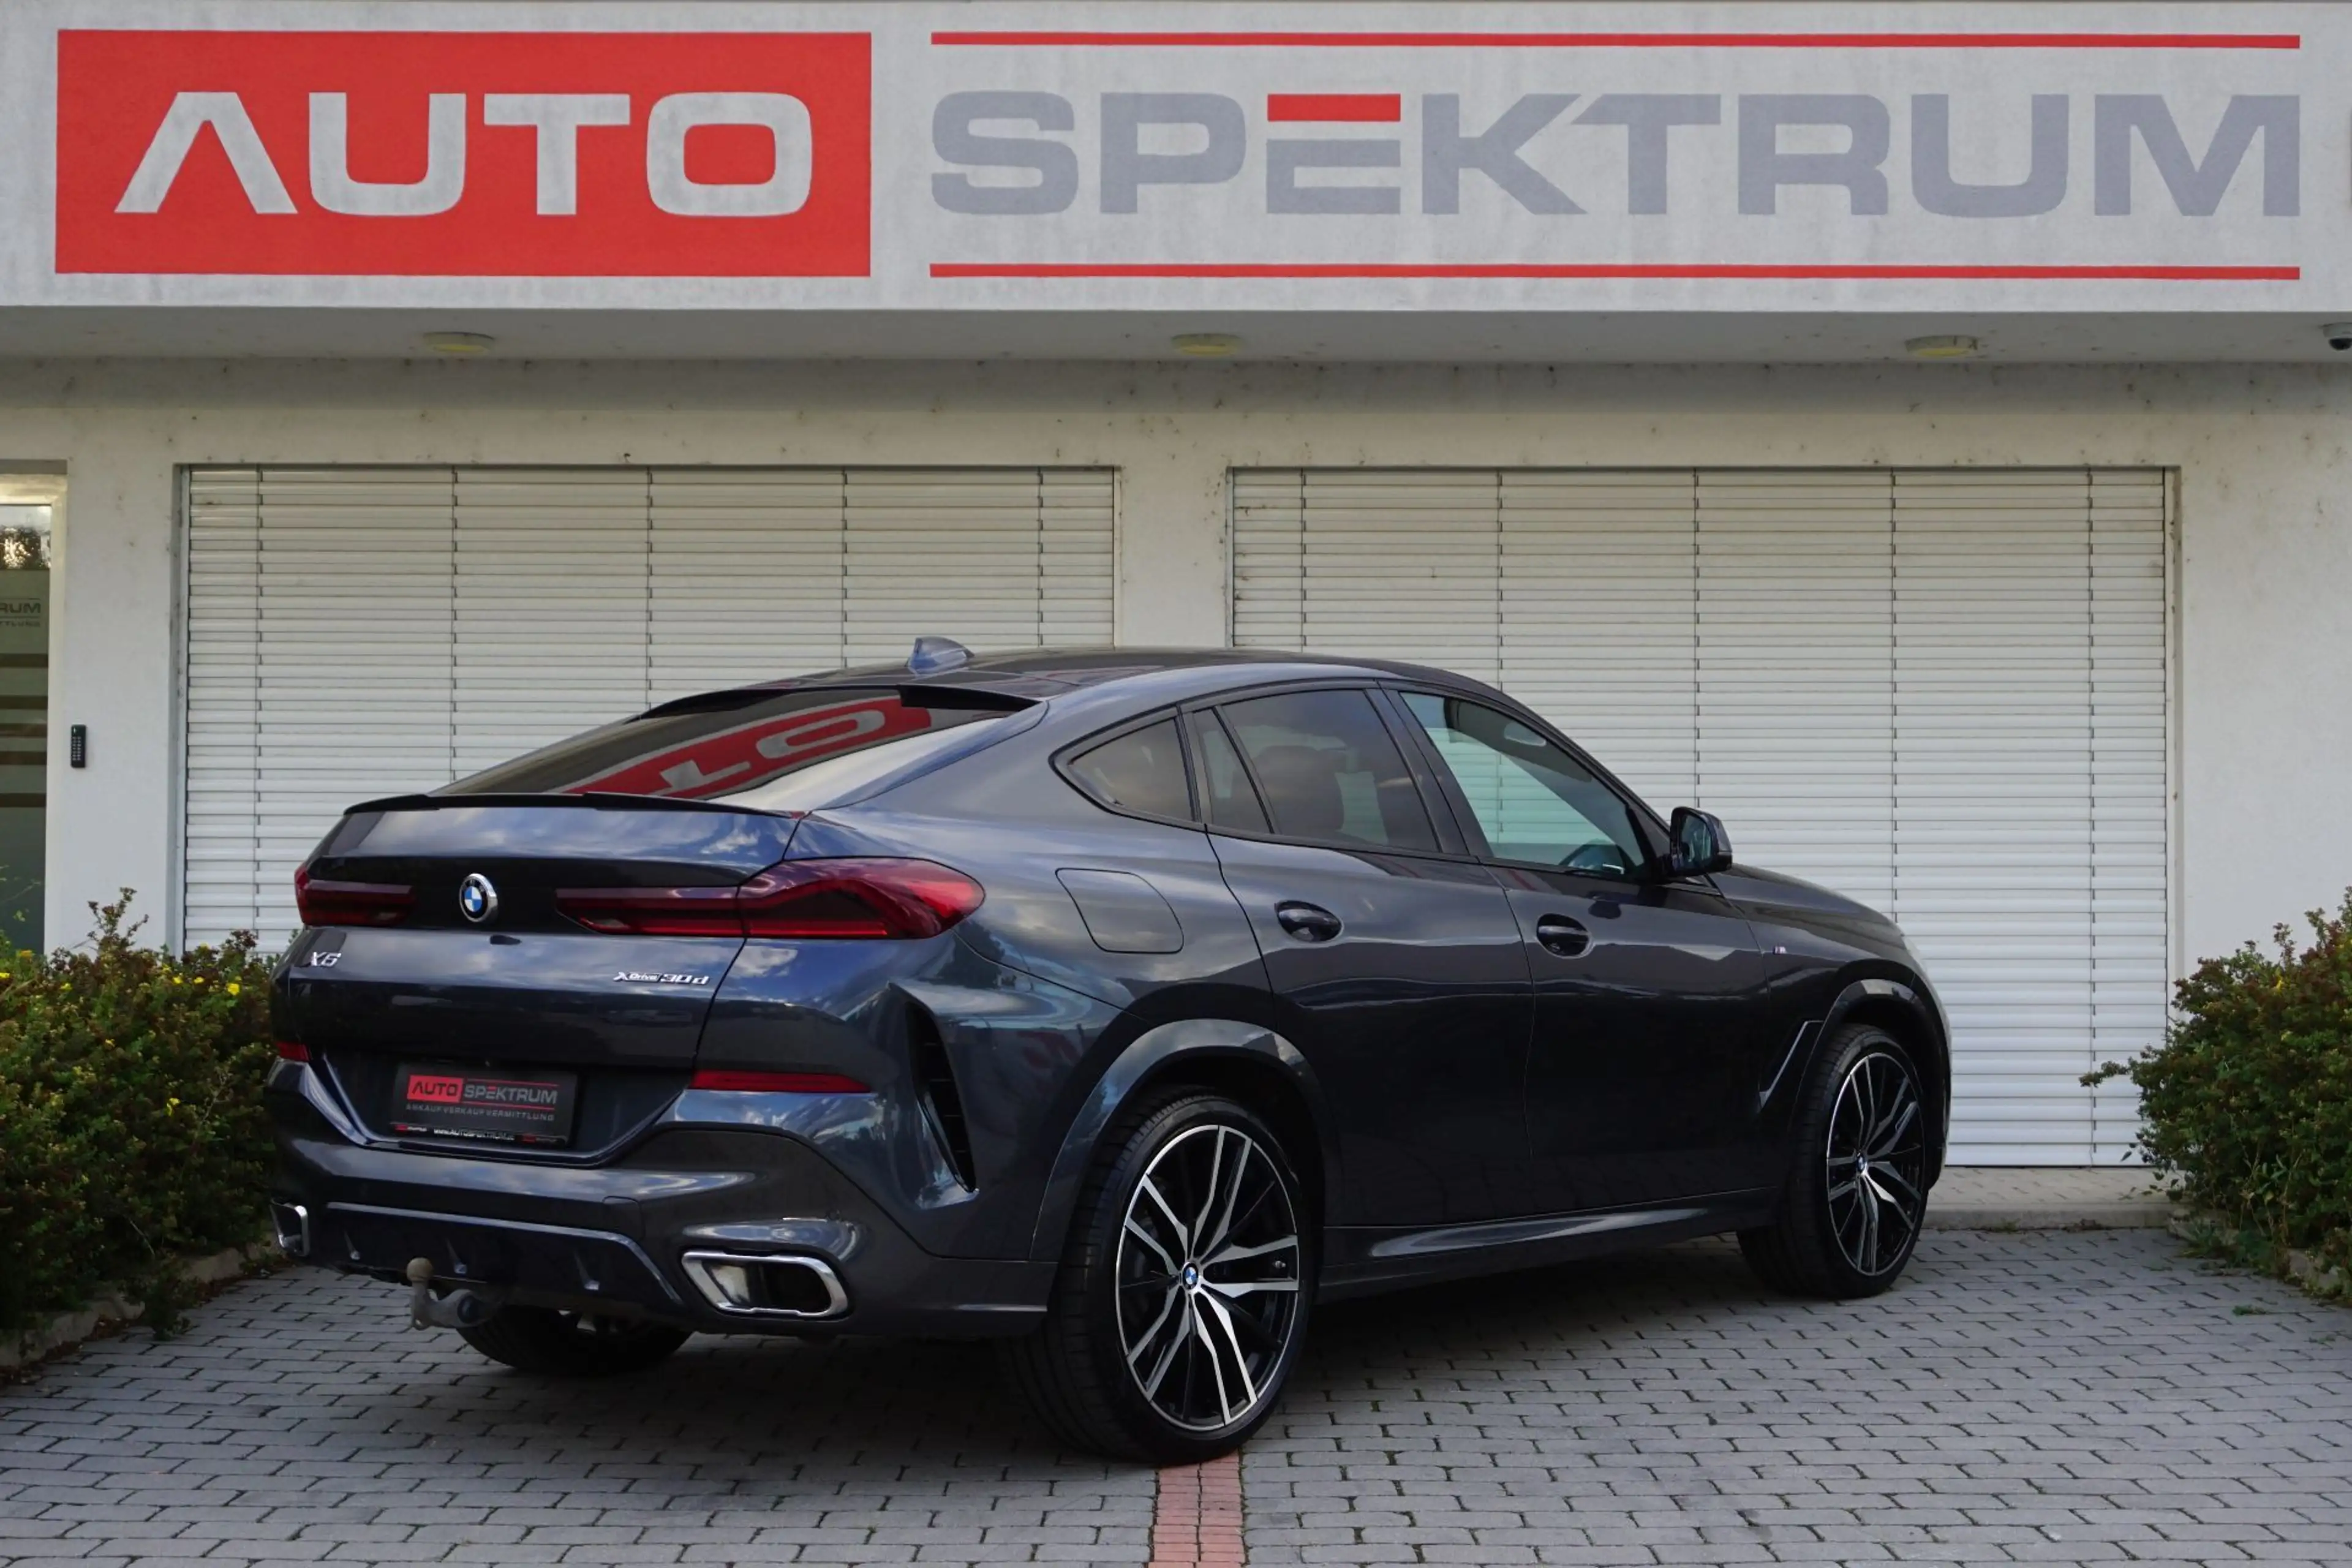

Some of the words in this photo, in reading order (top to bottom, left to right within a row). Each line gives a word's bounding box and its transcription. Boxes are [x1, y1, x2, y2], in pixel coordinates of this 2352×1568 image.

[114, 91, 812, 217] AUTO
[931, 91, 2300, 217] SPEKTRUM
[311, 951, 342, 967] X6
[412, 1081, 458, 1096] AUTO
[464, 1084, 558, 1104] SPEKTRUM
